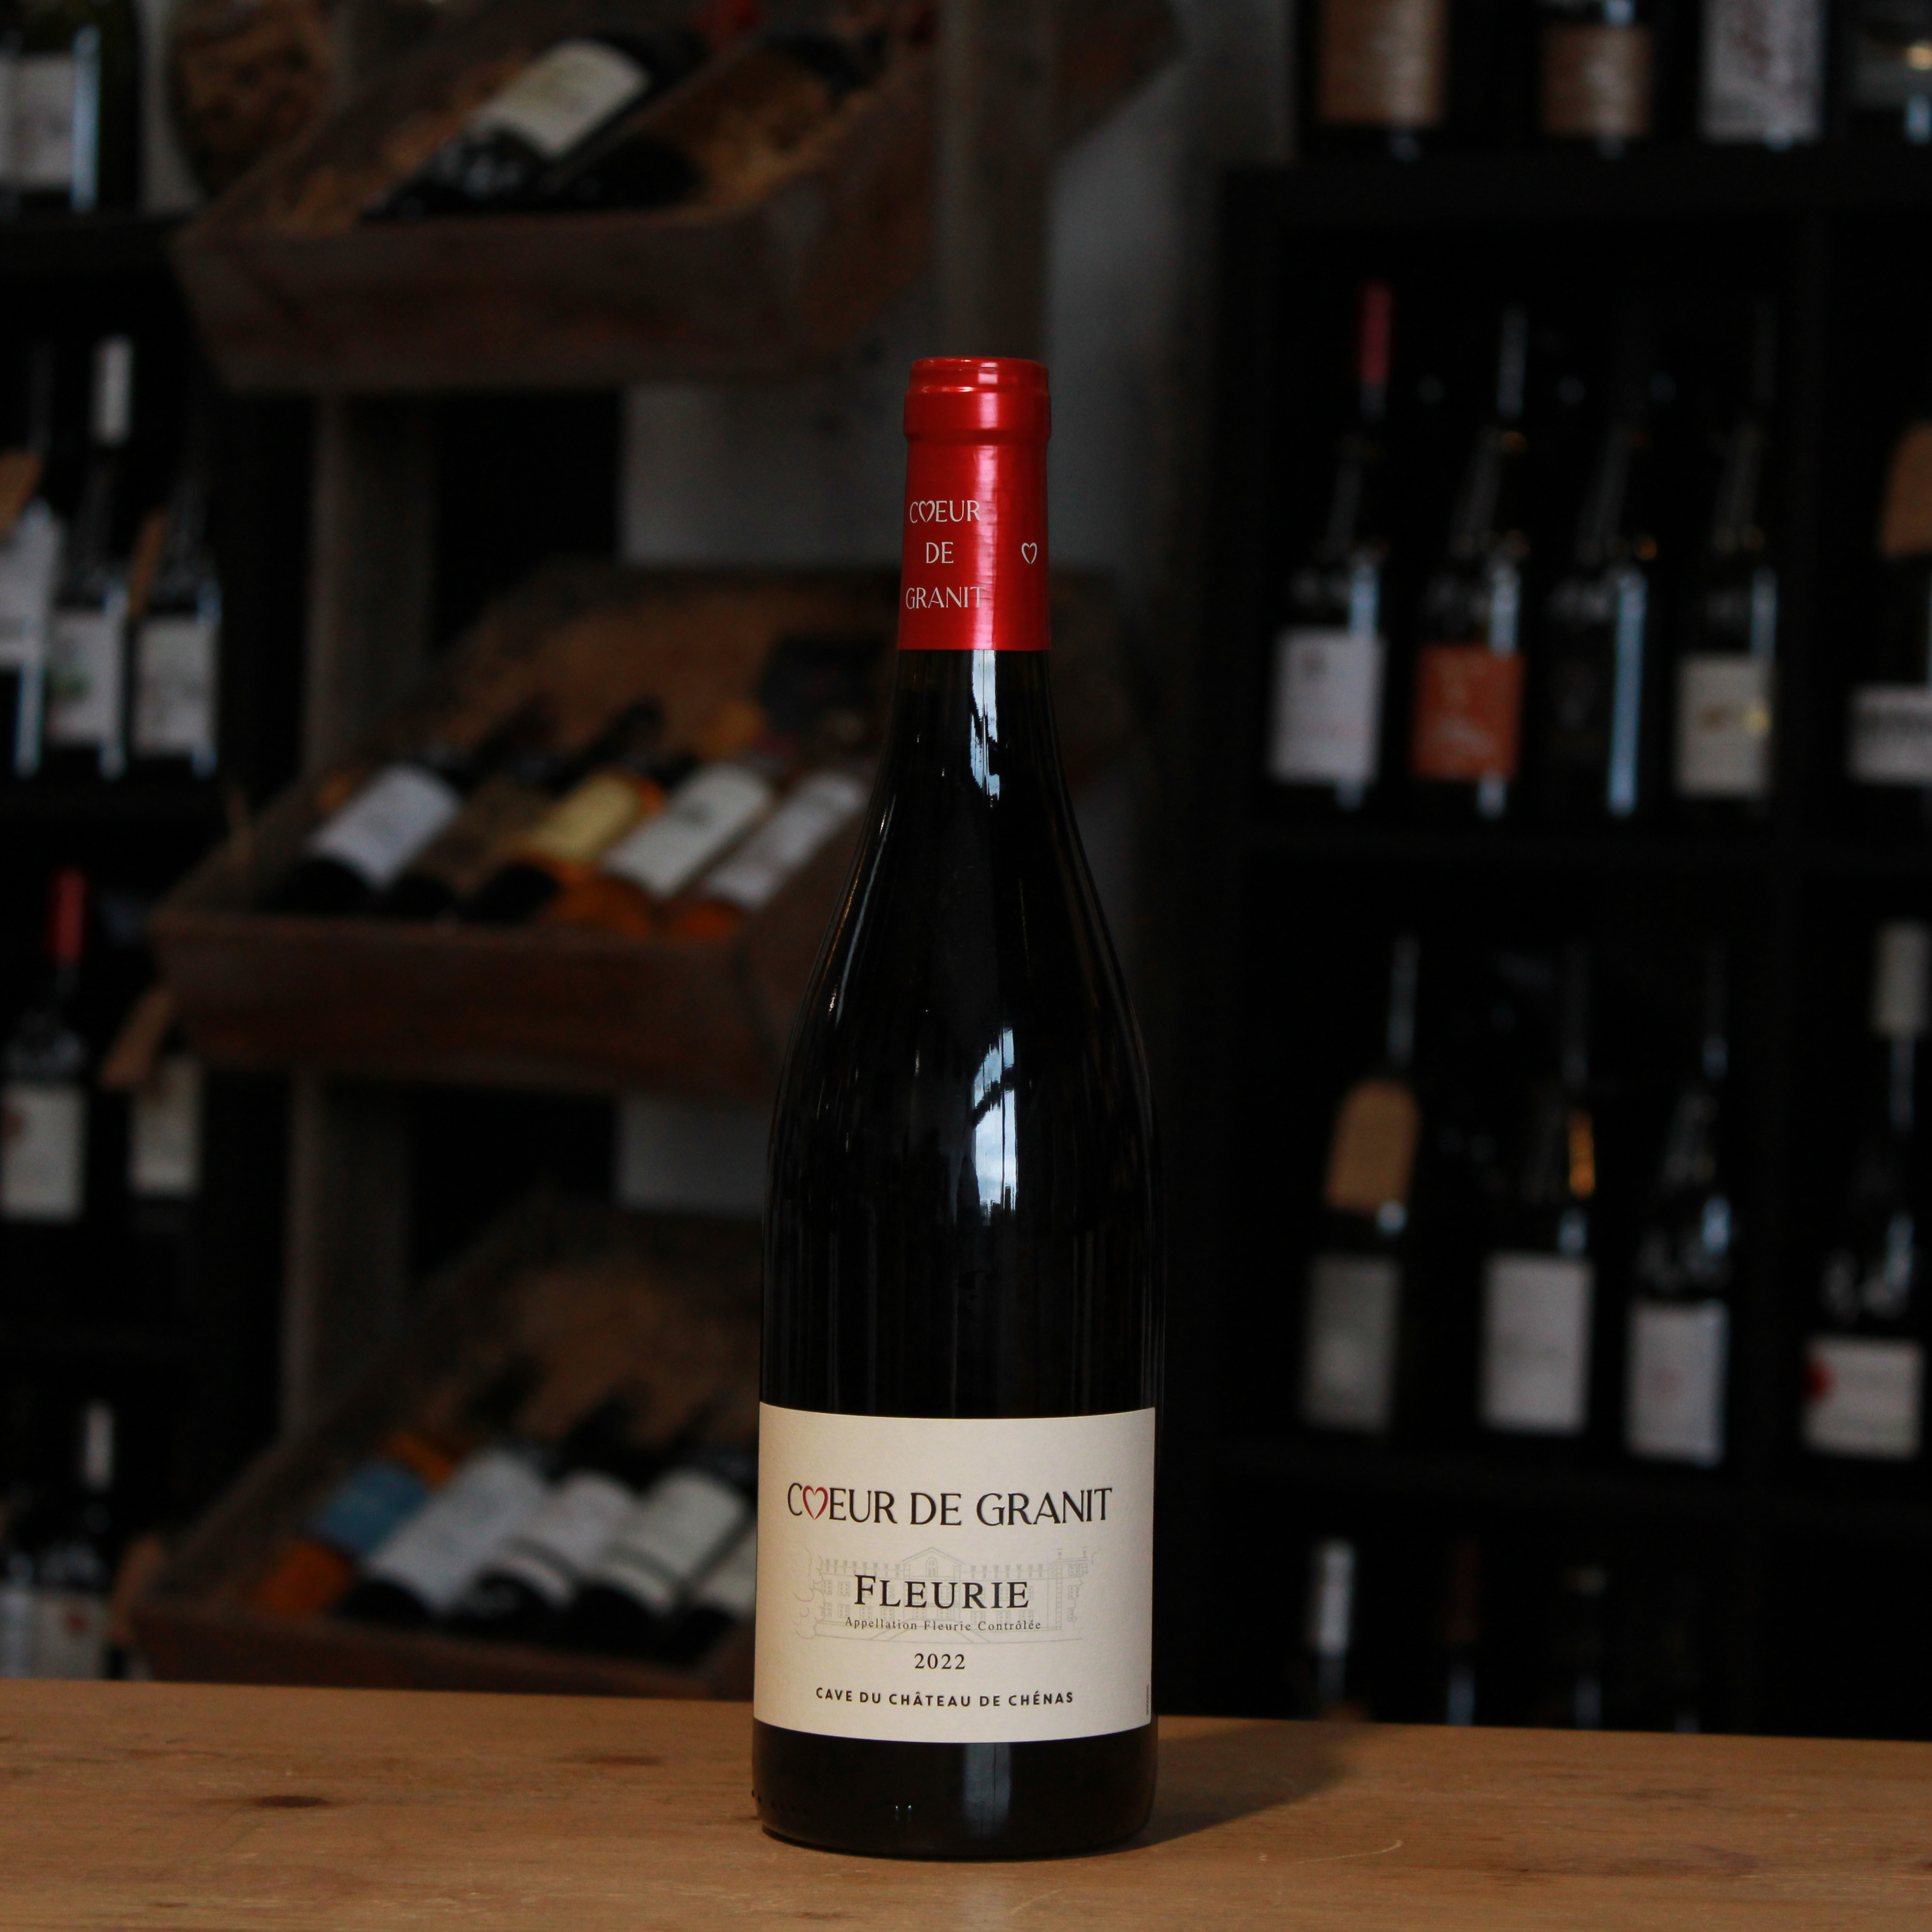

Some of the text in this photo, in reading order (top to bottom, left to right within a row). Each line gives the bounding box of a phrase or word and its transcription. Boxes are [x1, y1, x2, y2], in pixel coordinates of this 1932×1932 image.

[926, 541, 954, 564] DE
[906, 586, 986, 609] GRANIT
[910, 1492, 962, 1526] DE
[976, 1487, 1113, 1526] GRANIT
[845, 1616, 1041, 1631] Appellation Fleurie Contrôlée
[914, 1653, 966, 1670] 2022
[816, 1687, 1074, 1707] CAVE DU CHÂTEAU DE CHÉNAS
